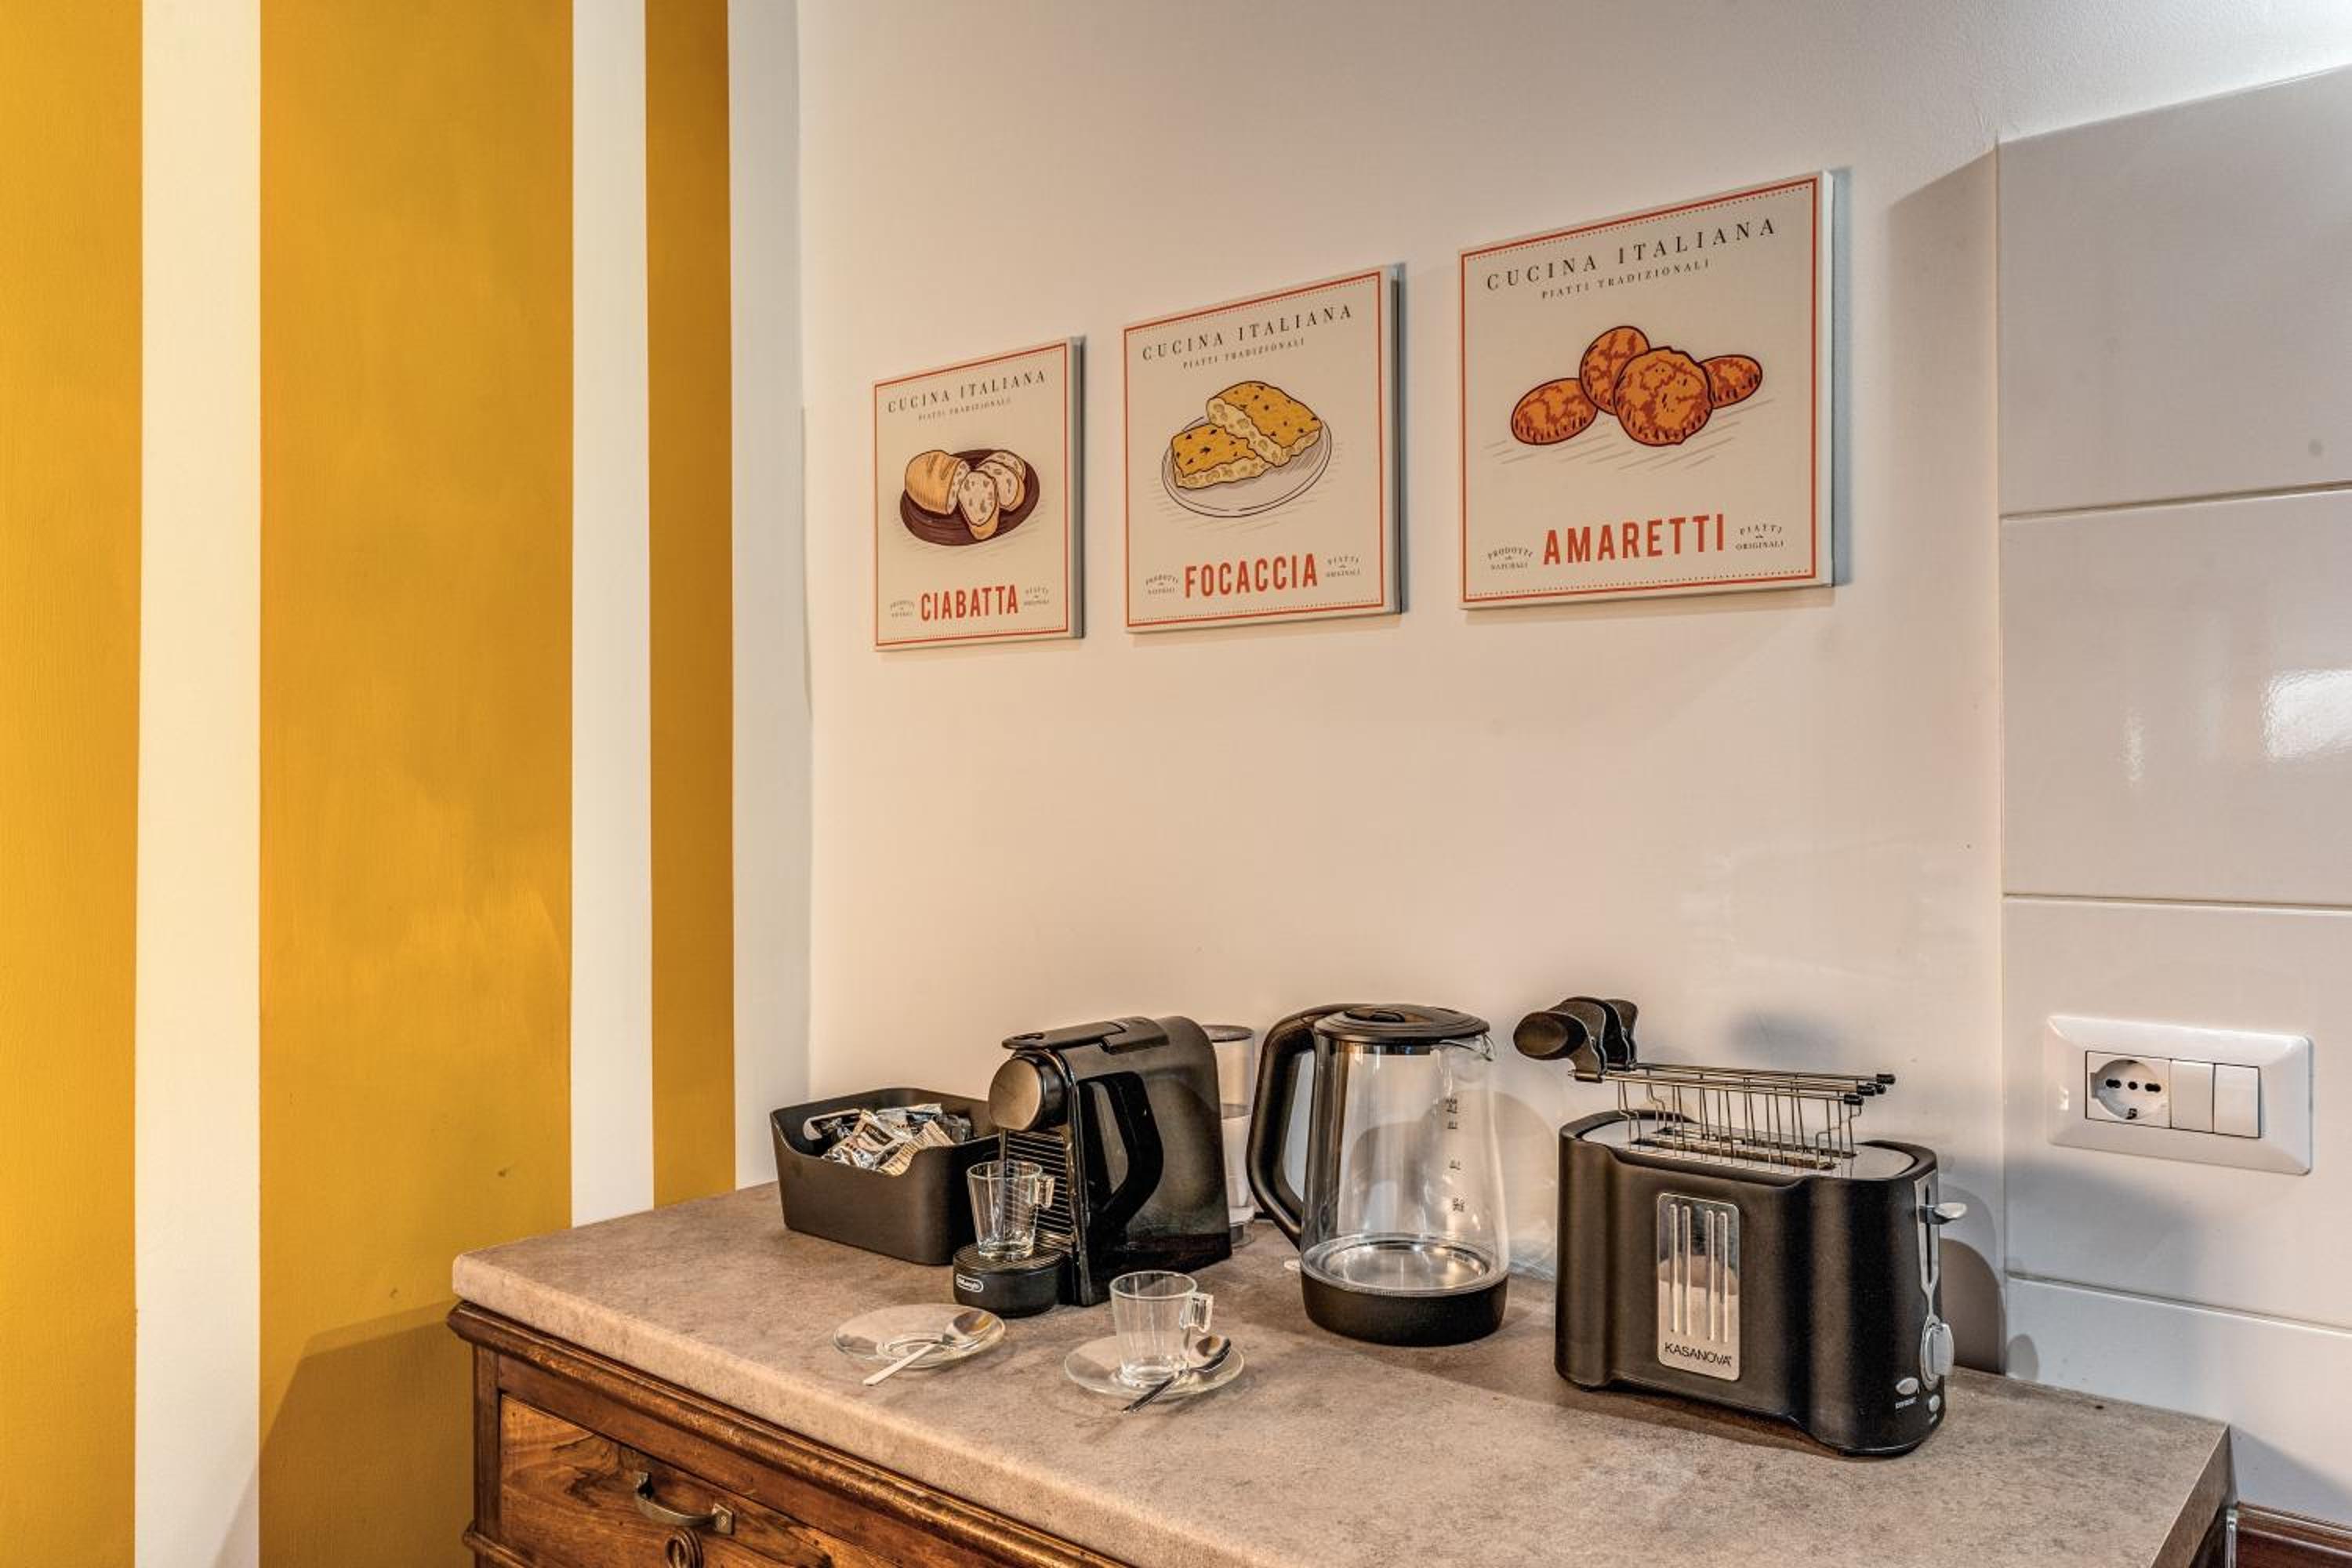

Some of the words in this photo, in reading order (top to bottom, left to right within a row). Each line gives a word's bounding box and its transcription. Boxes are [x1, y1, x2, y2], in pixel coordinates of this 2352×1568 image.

[1487, 255, 1596, 291] CUCINA
[1618, 218, 1775, 264] ITALIANA
[1541, 282, 1589, 299] PIATTI
[1598, 259, 1710, 288] TRADIZIONALI
[1142, 332, 1223, 361] CUCINA
[1238, 304, 1352, 341] ITALIANA
[1183, 355, 1218, 369] PIATTI
[1225, 337, 1305, 361] TRADIZIONALI
[888, 390, 950, 413] CUCINA
[960, 370, 1046, 399] ITALIANA
[1543, 513, 1724, 565] AMARETTI
[1735, 539, 1784, 551] ORIGINALI
[1740, 524, 1782, 535] PIATTI
[1487, 546, 1534, 560] PRODOTTI
[1185, 553, 1318, 598] FOCACCIA
[920, 585, 1018, 622] CIABATTA
[1664, 1342, 1732, 1367] KASANOVA
